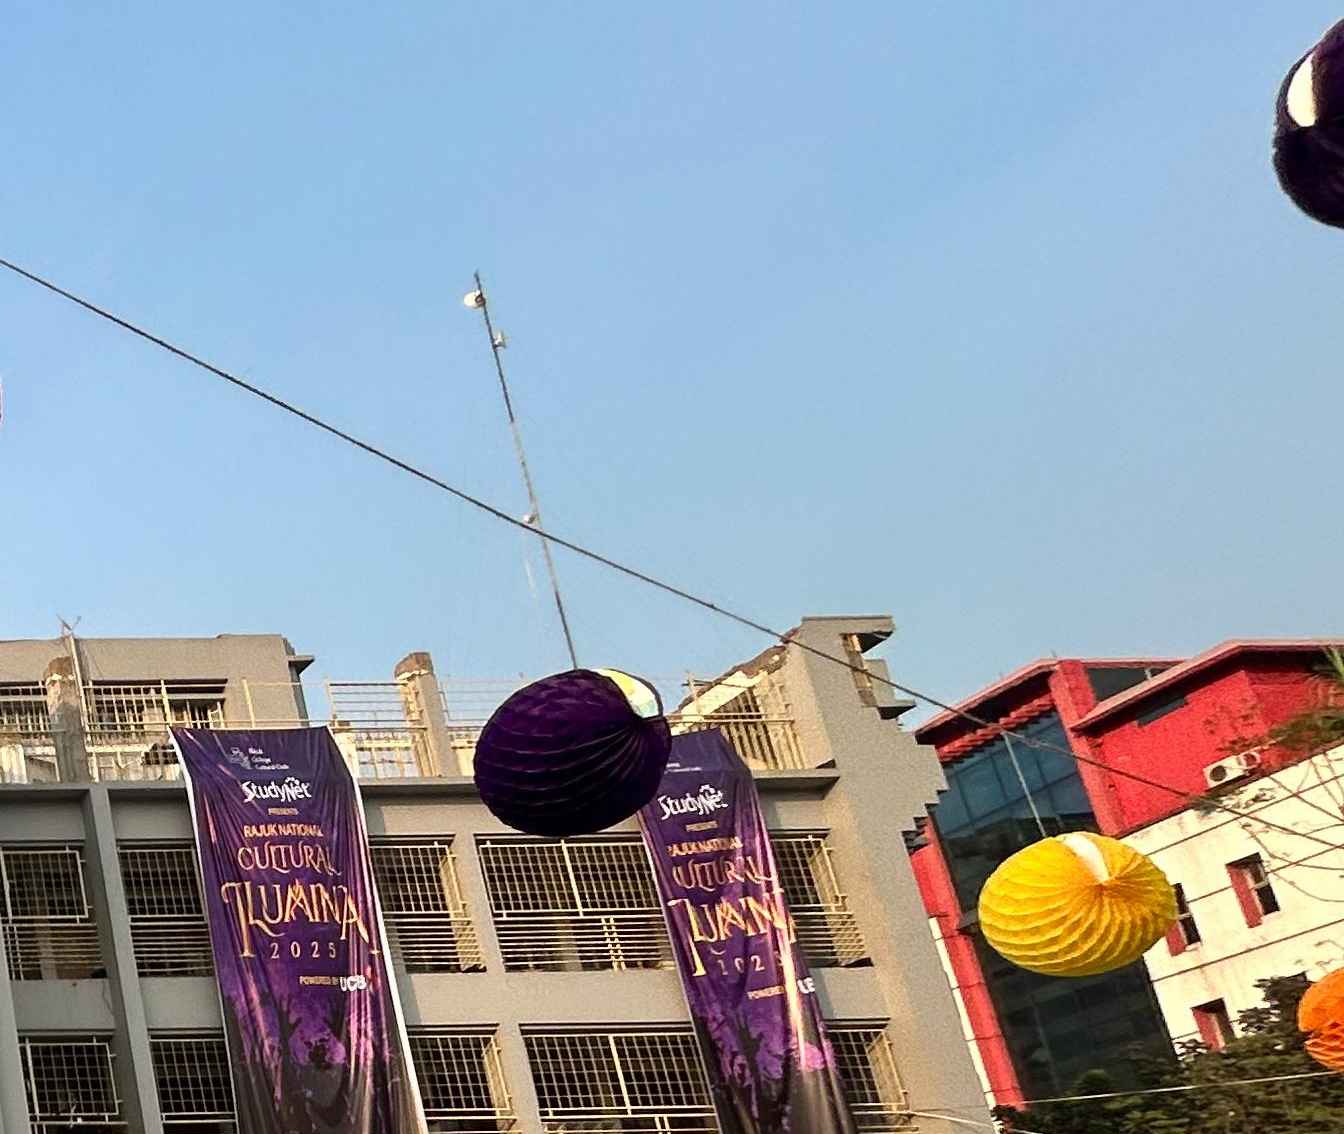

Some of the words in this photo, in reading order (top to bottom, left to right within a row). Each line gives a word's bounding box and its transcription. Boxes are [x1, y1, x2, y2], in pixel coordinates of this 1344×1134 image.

[242, 777, 312, 802] StudyNet
[237, 841, 342, 876] CULTURAL
[270, 941, 337, 959] 2025
